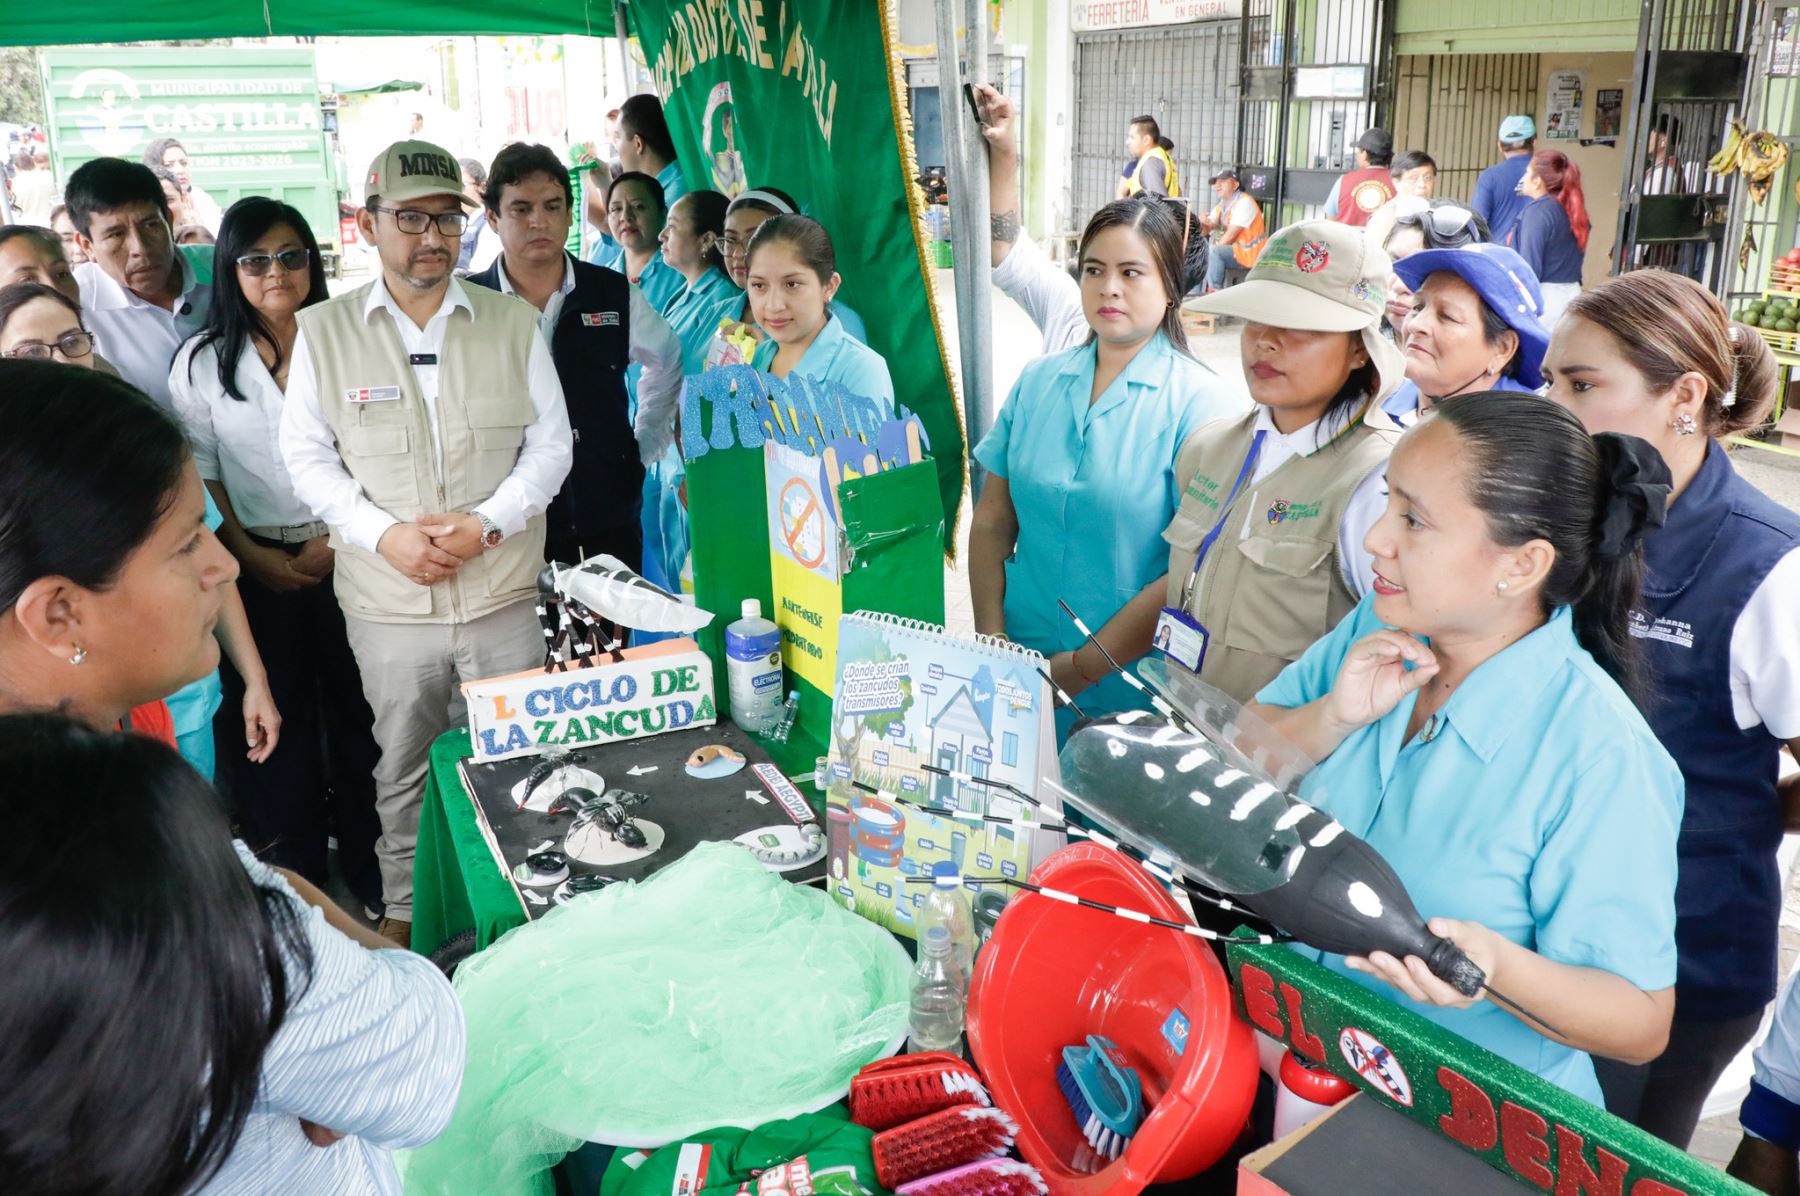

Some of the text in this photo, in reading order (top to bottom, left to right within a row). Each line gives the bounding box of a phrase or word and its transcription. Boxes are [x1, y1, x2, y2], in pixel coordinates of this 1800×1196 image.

[1175, 2, 1228, 18] EN GENERAL
[151, 80, 304, 96] MUNICIPALIDAD DE
[144, 102, 319, 133] CASTILLA
[398, 152, 459, 184] MINSA
[876, 664, 887, 676] se
[524, 674, 637, 718] CICLO
[651, 664, 700, 698] DE
[844, 678, 899, 694] los zancudos
[844, 691, 904, 710] transmisores?
[1240, 963, 1326, 1063] EL
[1437, 1066, 1694, 1196] DEN
